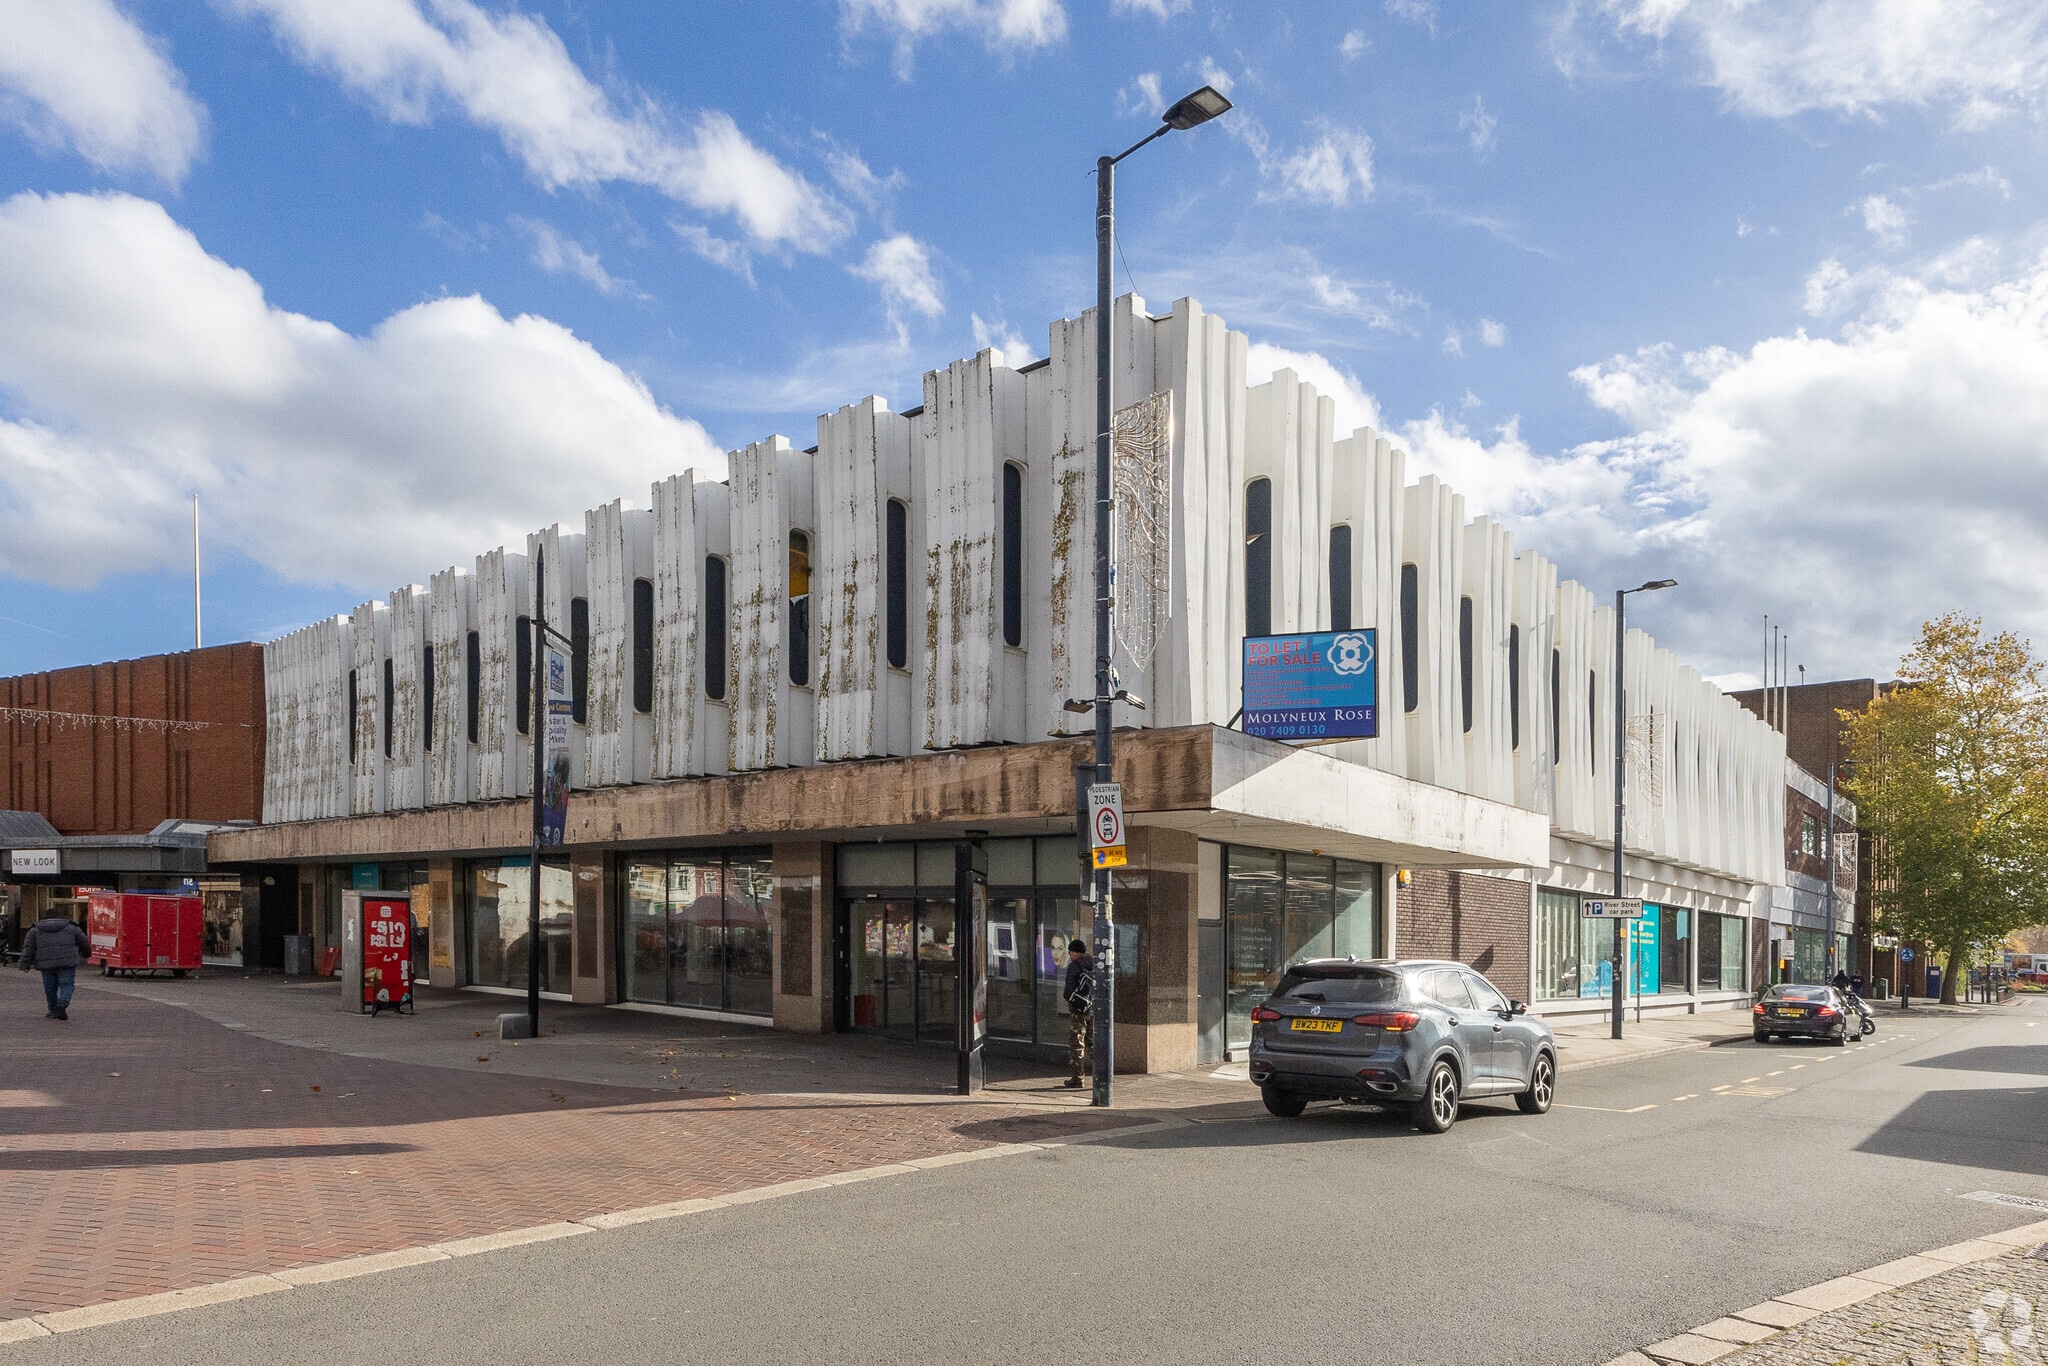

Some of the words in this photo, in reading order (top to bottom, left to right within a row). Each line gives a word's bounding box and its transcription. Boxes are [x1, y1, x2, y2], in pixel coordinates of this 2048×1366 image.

[1248, 643, 1270, 655] TO
[1274, 641, 1301, 653] LET
[1306, 640, 1311, 651] /
[1248, 655, 1279, 667] FOR
[1283, 652, 1321, 665] SALE
[1247, 711, 1327, 724] MOLYNEUX
[1247, 727, 1267, 736] 020
[1270, 725, 1296, 735] 7409
[1298, 724, 1326, 734] 0130
[1094, 795, 1116, 805] ZONE
[13, 857, 31, 867] NEW
[33, 857, 56, 867] LOOK
[1594, 903, 1601, 913] P
[1620, 908, 1634, 916] park
[1295, 1020, 1318, 1029] BW23
[1320, 1021, 1339, 1031] TKF
